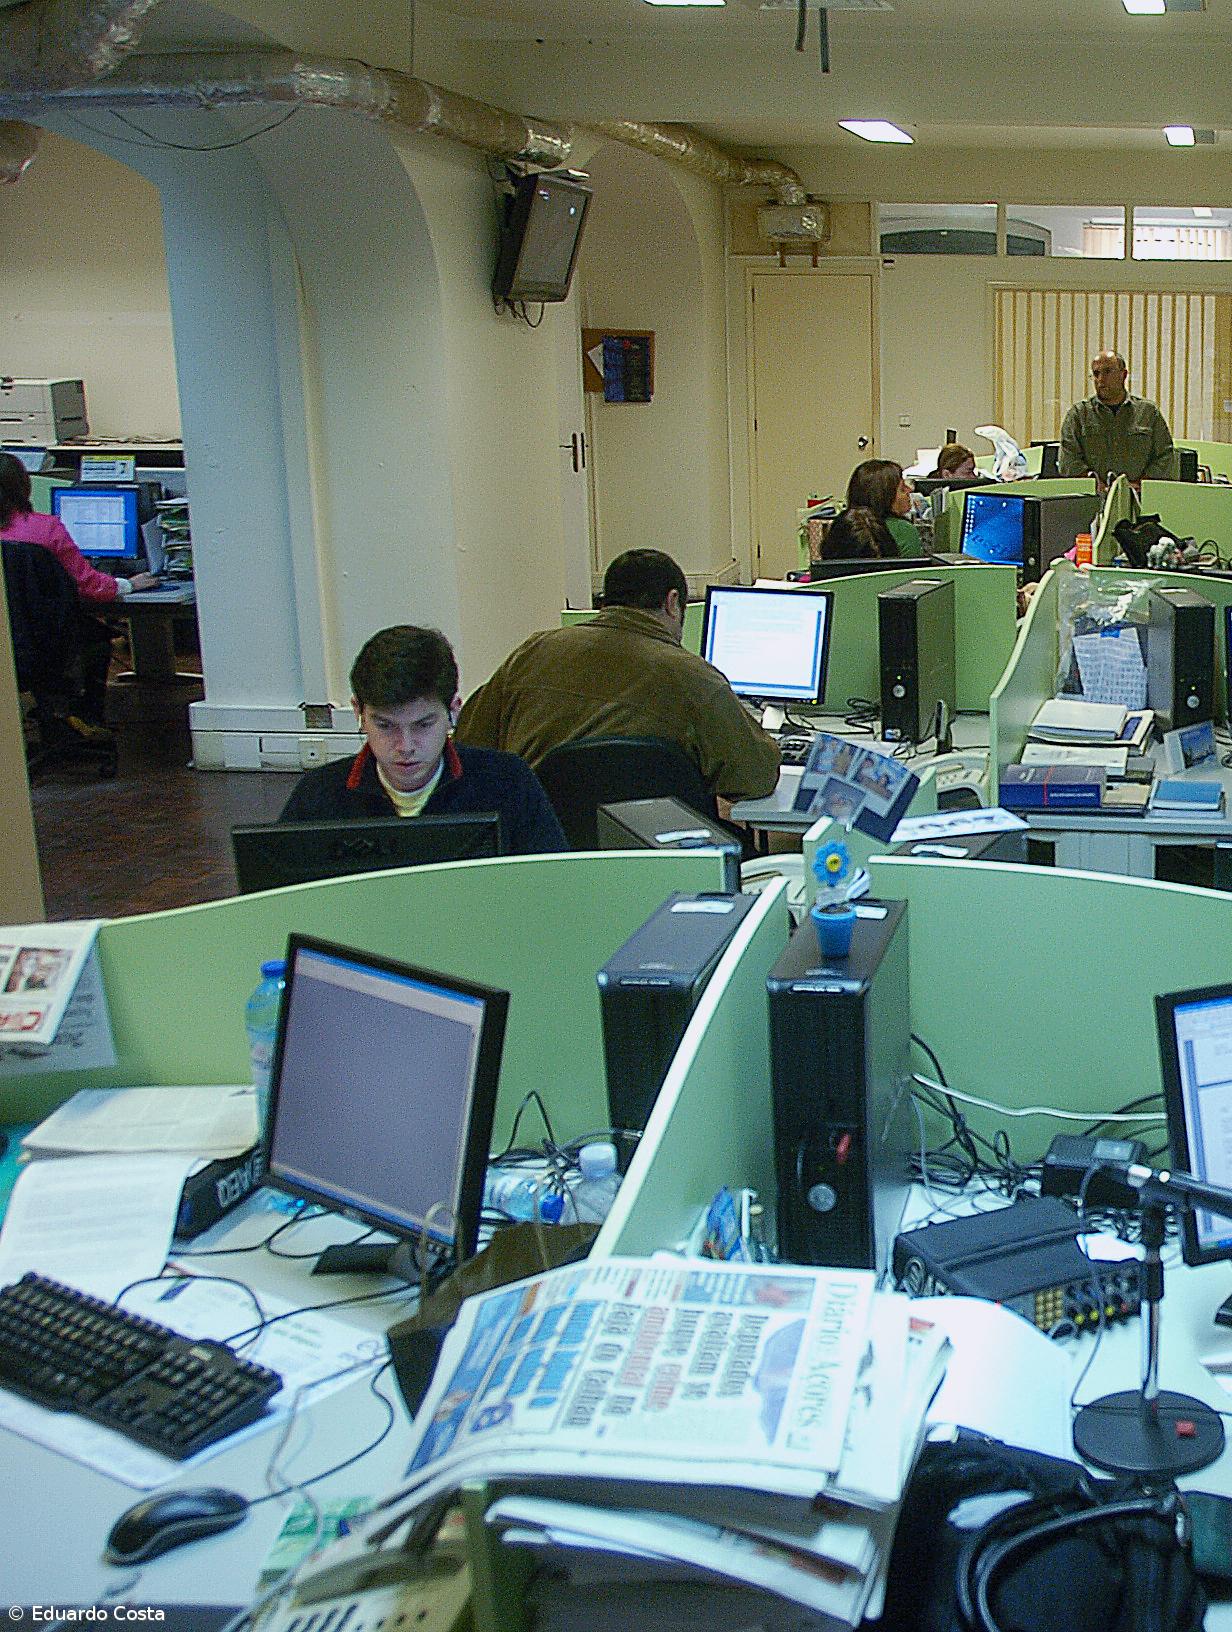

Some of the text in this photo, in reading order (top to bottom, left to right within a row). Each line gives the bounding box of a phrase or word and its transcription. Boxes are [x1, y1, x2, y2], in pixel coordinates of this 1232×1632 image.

[816, 1281, 859, 1346] Diário
[716, 1314, 769, 1399] Deputados
[794, 1360, 840, 1429] Açores
